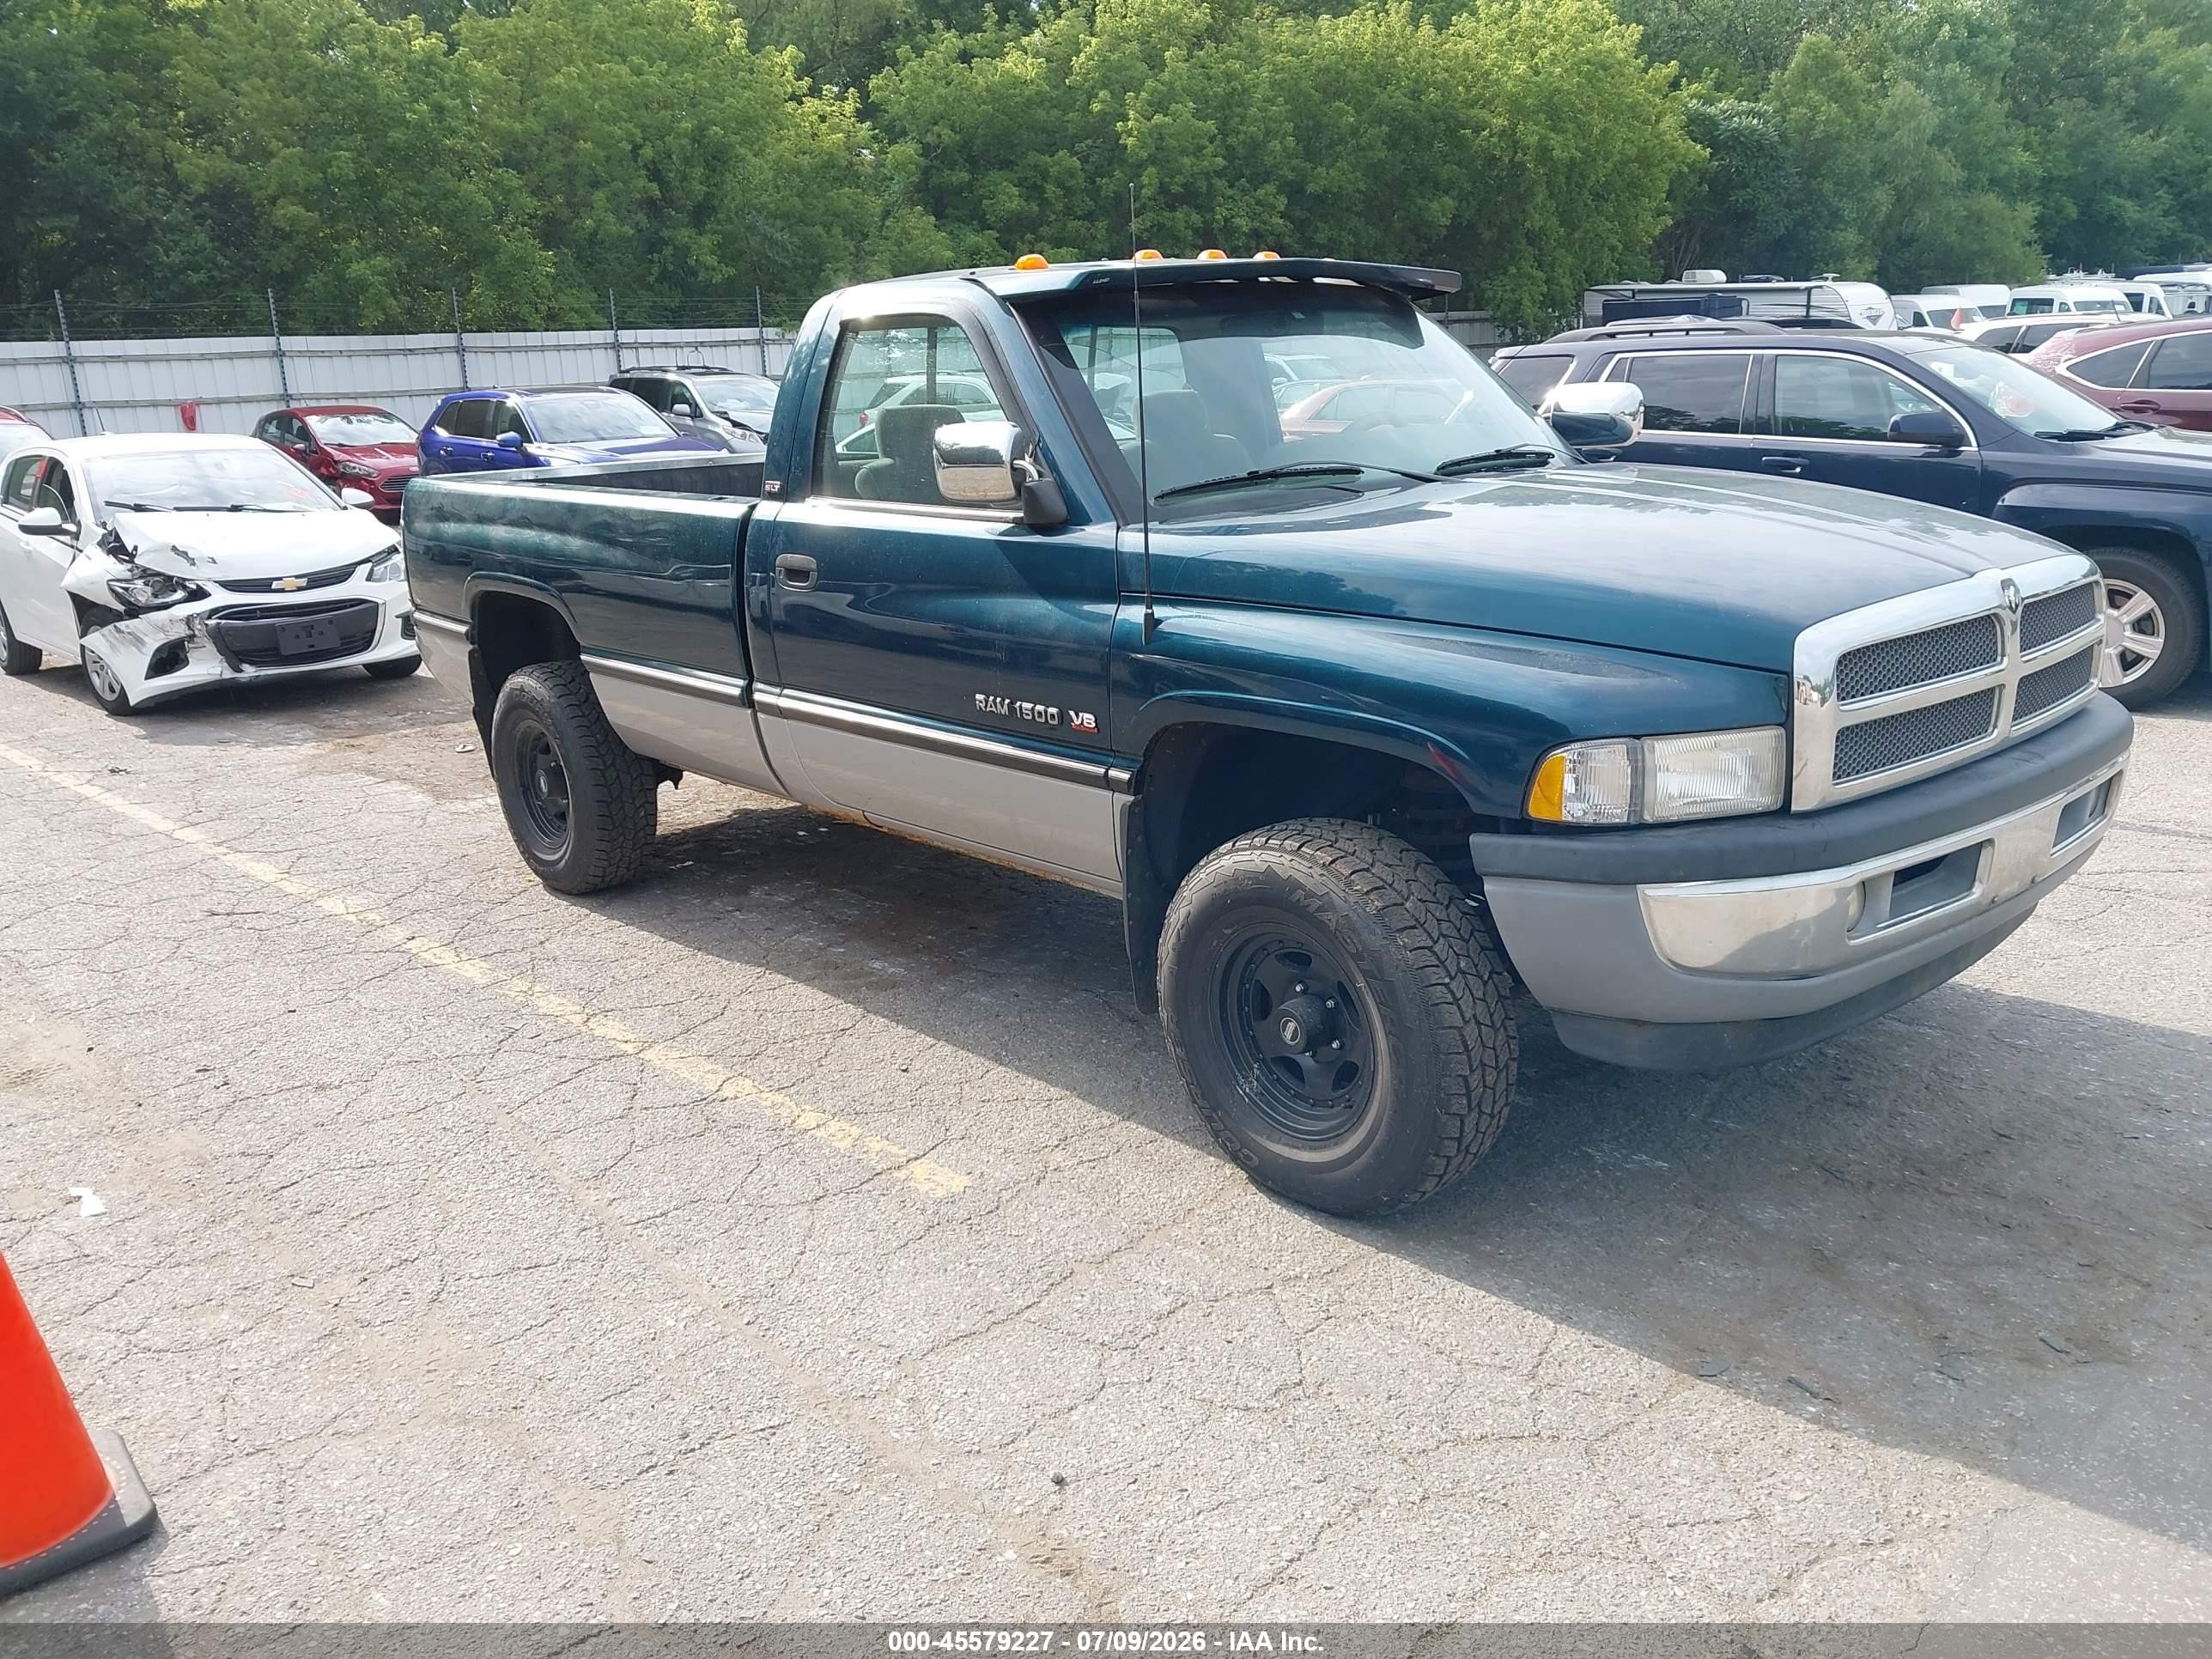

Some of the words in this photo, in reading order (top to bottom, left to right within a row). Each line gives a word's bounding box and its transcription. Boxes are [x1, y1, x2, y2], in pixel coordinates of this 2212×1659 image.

[764, 483, 781, 492] SLT
[975, 693, 1012, 715] RAM
[1013, 700, 1060, 726] 1500
[1068, 709, 1097, 728] V8
